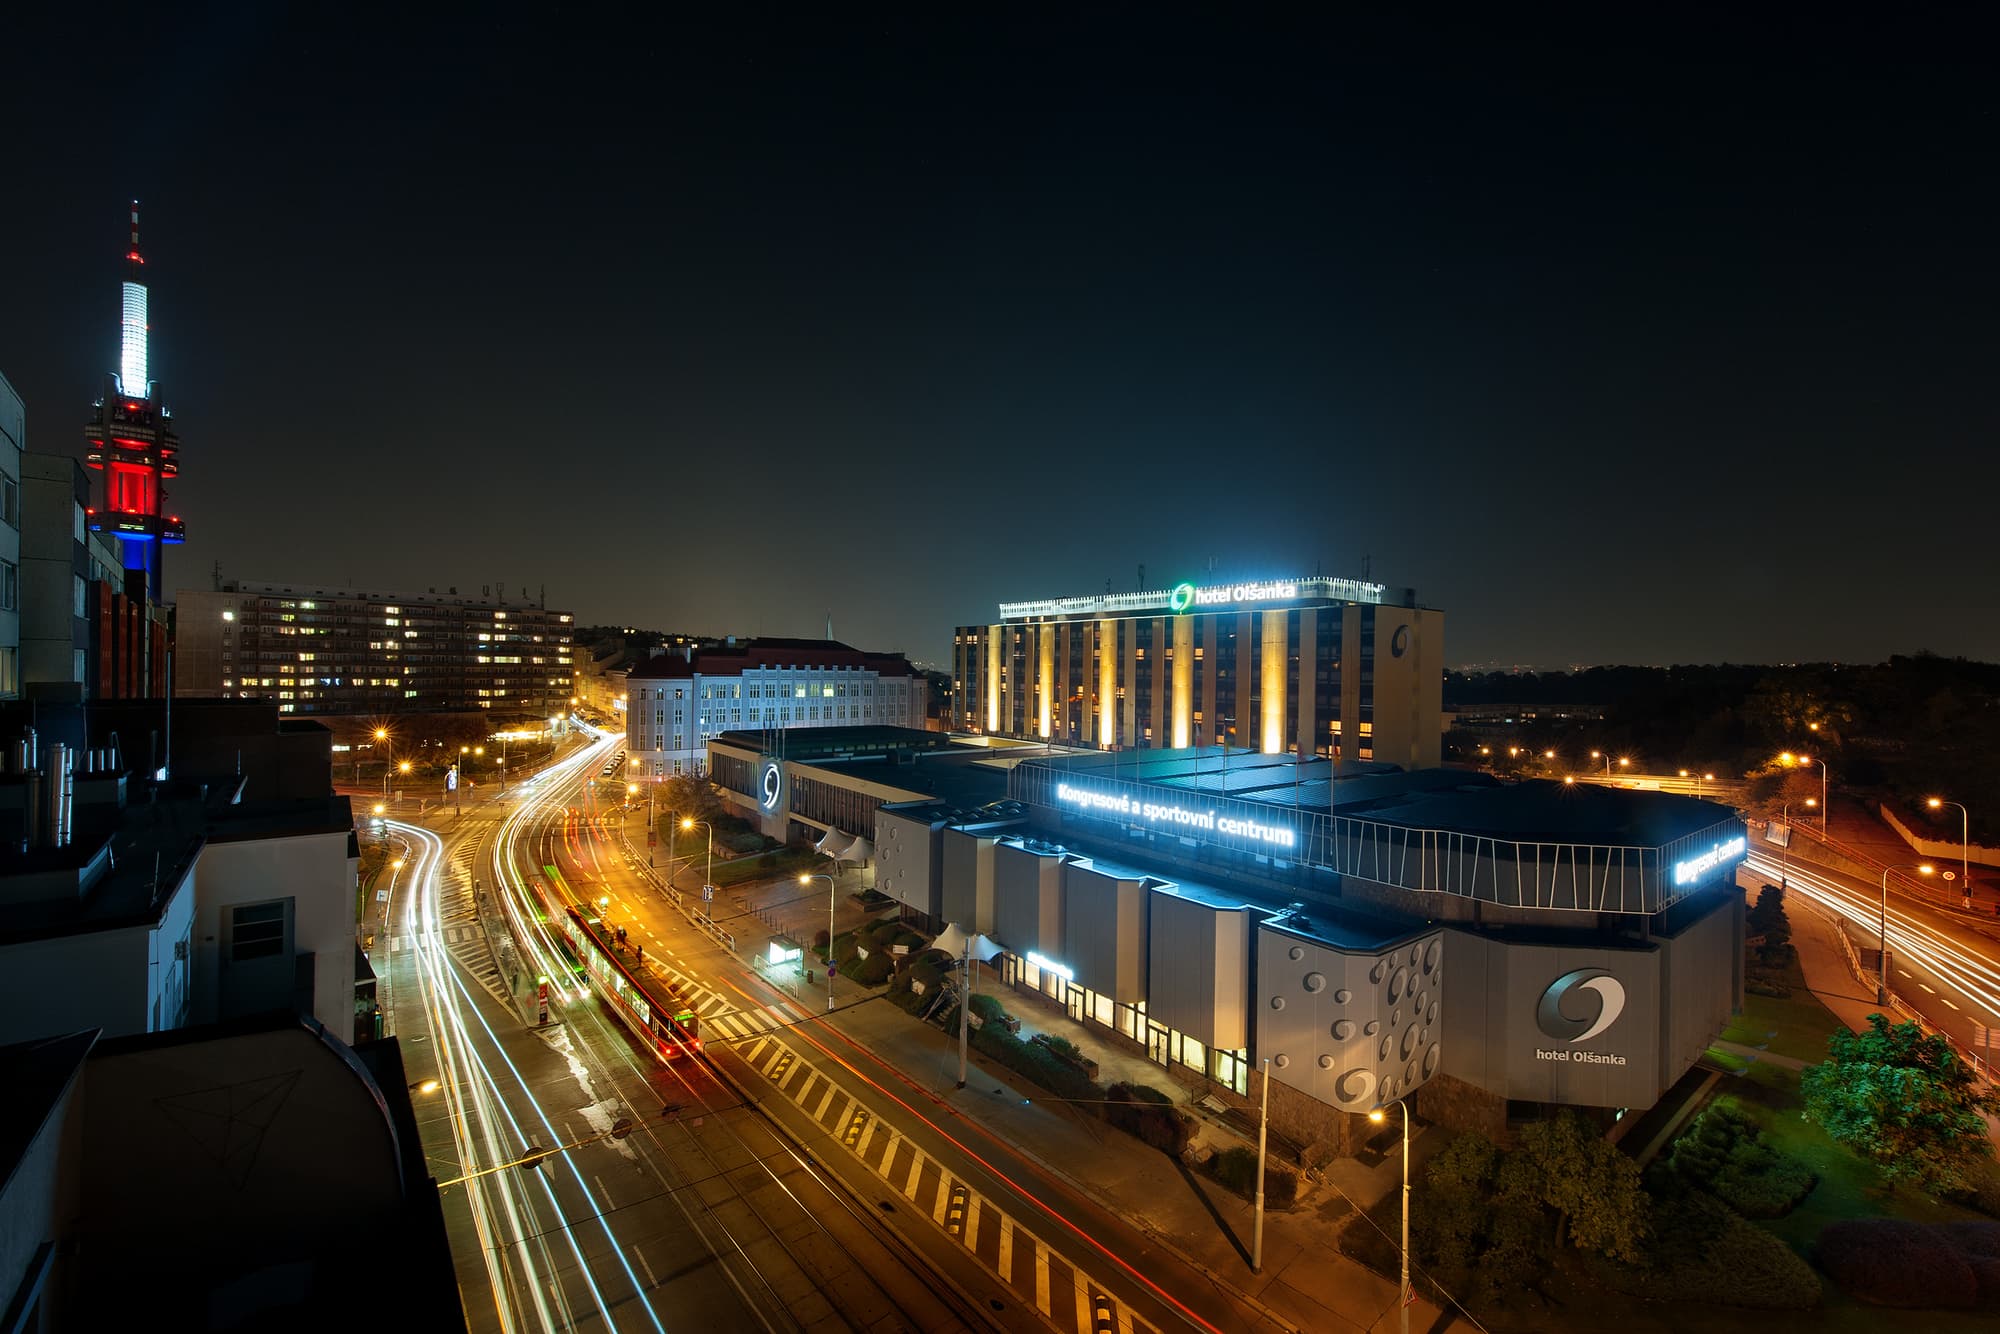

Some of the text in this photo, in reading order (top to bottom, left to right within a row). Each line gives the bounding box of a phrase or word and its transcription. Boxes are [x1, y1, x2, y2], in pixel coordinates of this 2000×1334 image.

[1195, 583, 1296, 604] hotel Olšanka
[1057, 783, 1294, 846] Kongresové a sportovní centrum
[1536, 1049, 1626, 1065] hotel Olšanka
